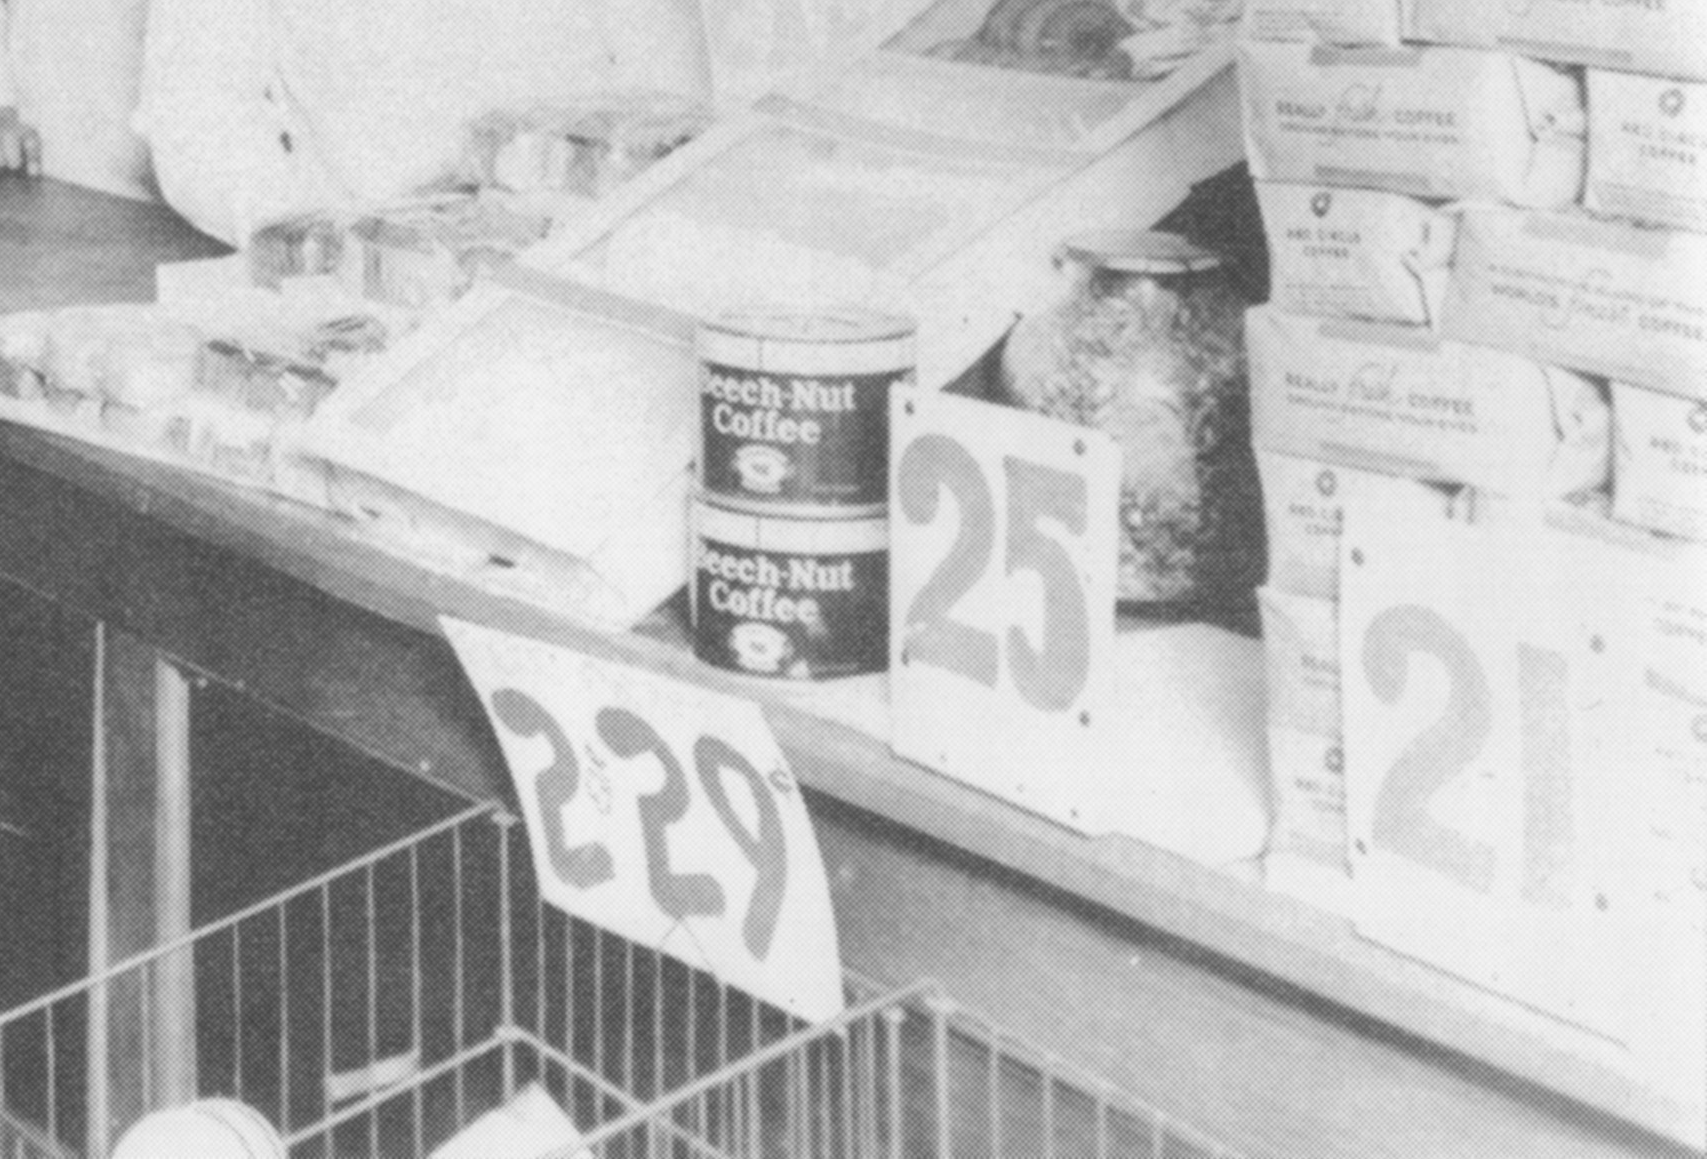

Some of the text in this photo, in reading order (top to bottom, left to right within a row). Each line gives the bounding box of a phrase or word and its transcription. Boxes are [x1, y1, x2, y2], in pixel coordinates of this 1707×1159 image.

[712, 402, 822, 446] Coffee
[708, 579, 820, 624] Coffee
[896, 432, 1091, 713] 25
[491, 686, 616, 890] 2
[593, 705, 789, 962] 29
[1361, 602, 1577, 911] 21
